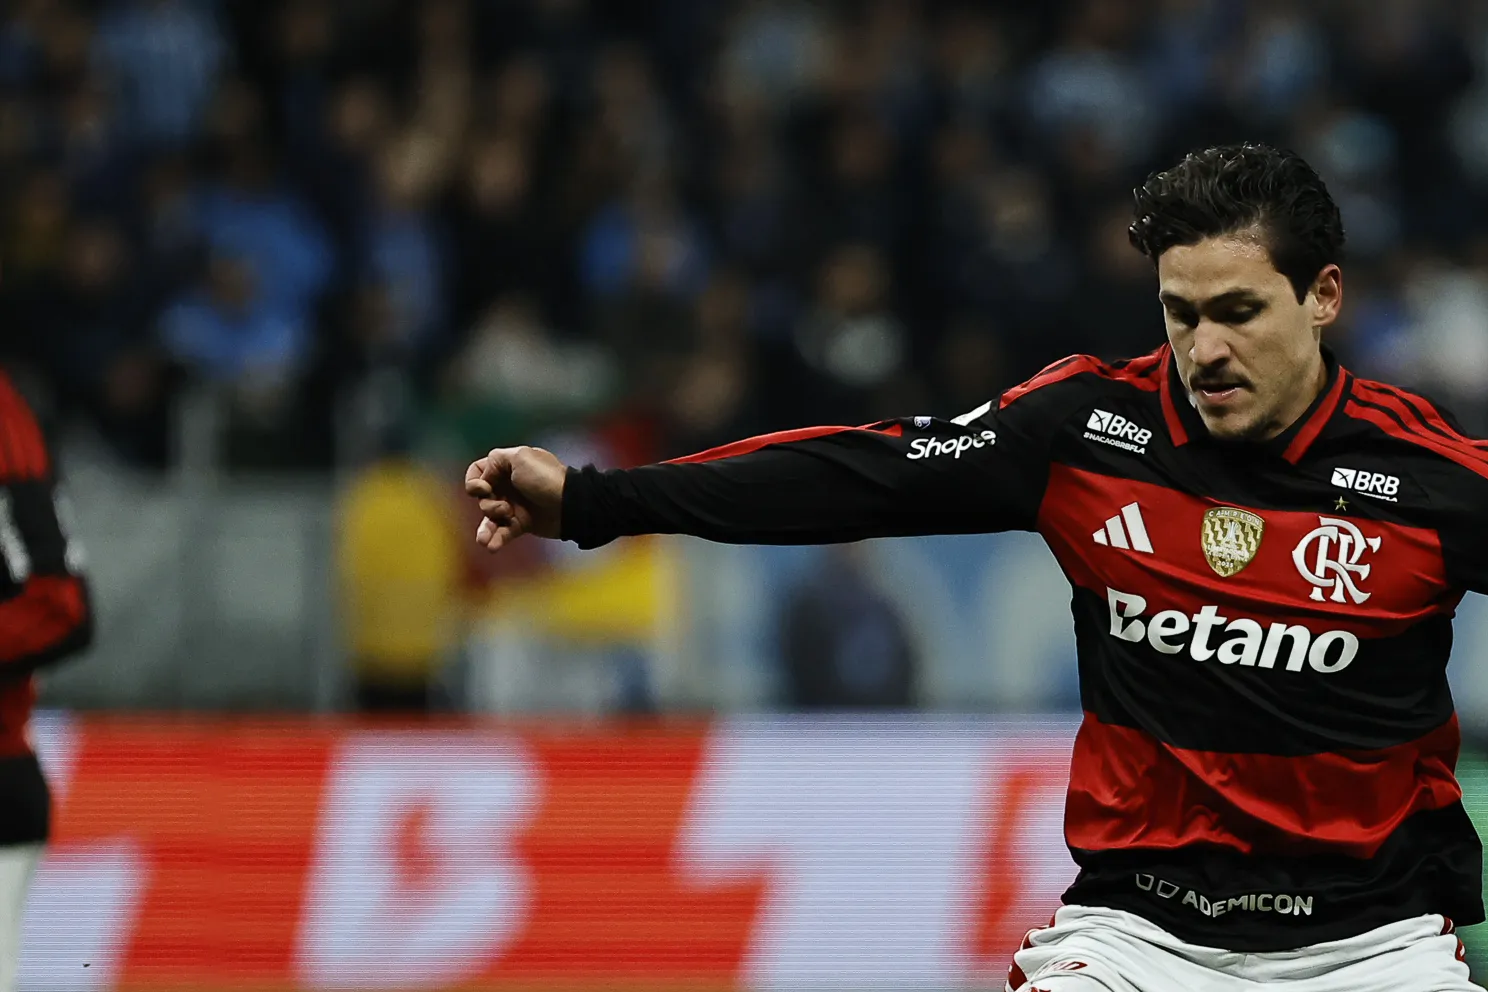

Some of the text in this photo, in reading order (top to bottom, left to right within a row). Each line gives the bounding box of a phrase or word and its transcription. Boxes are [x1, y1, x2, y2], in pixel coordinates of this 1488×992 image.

[1107, 414, 1153, 445] BRB
[906, 430, 997, 460] Shopee
[1354, 470, 1400, 496] BRB
[1107, 586, 1359, 674] Betano
[1181, 890, 1313, 918] ADEMICON
